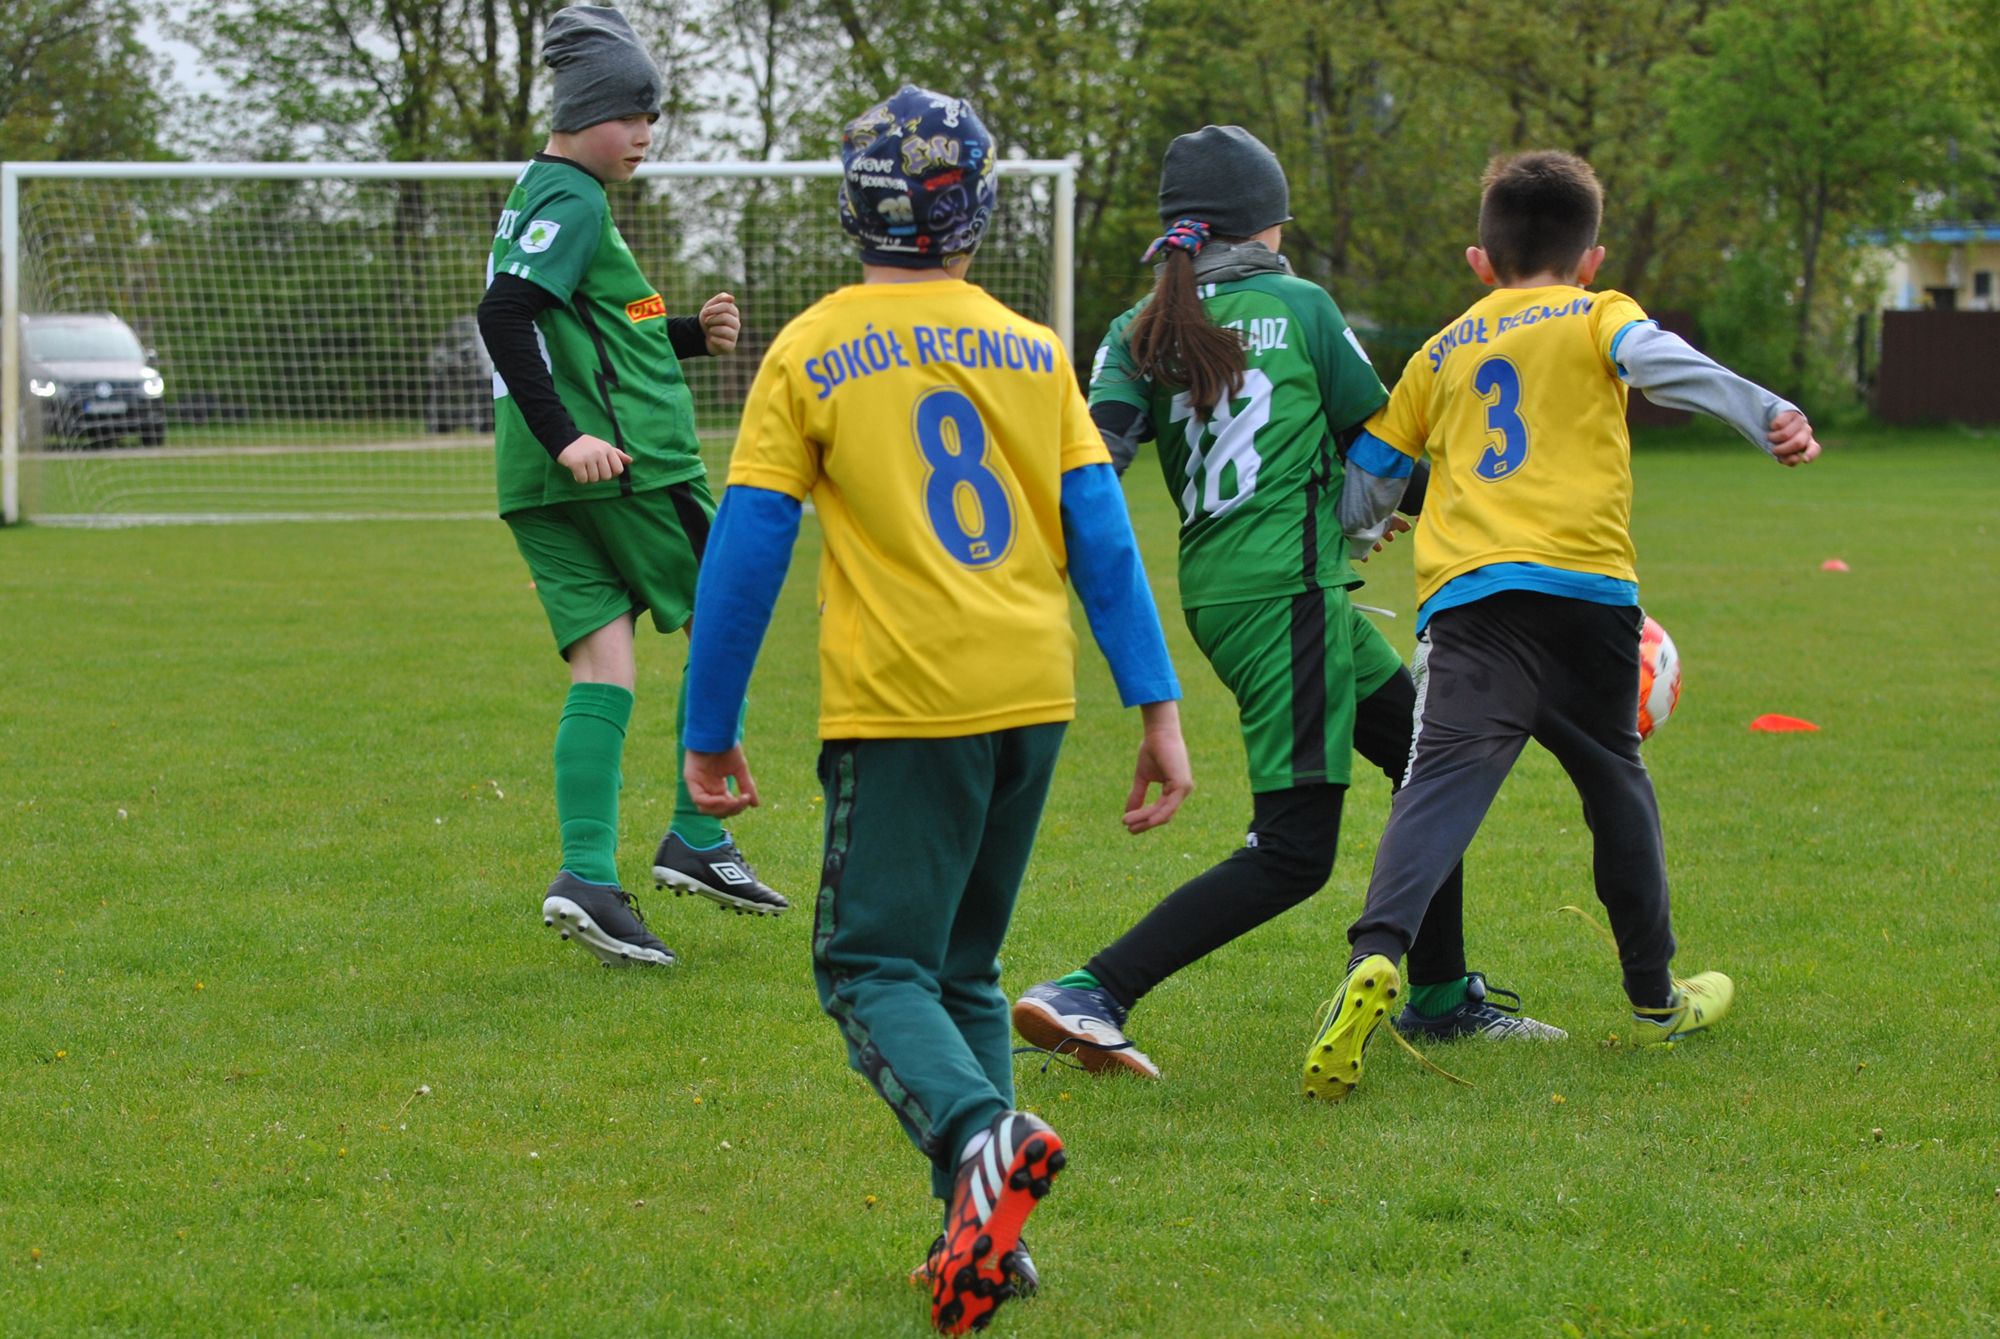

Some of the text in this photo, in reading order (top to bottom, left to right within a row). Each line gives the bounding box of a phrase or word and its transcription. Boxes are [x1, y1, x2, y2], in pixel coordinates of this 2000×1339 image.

[805, 323, 1054, 401] SOKÓŁ REGNÓW
[1428, 314, 1489, 374] SOKÓŁ
[1472, 355, 1530, 483] 3
[911, 385, 1017, 571] 8
